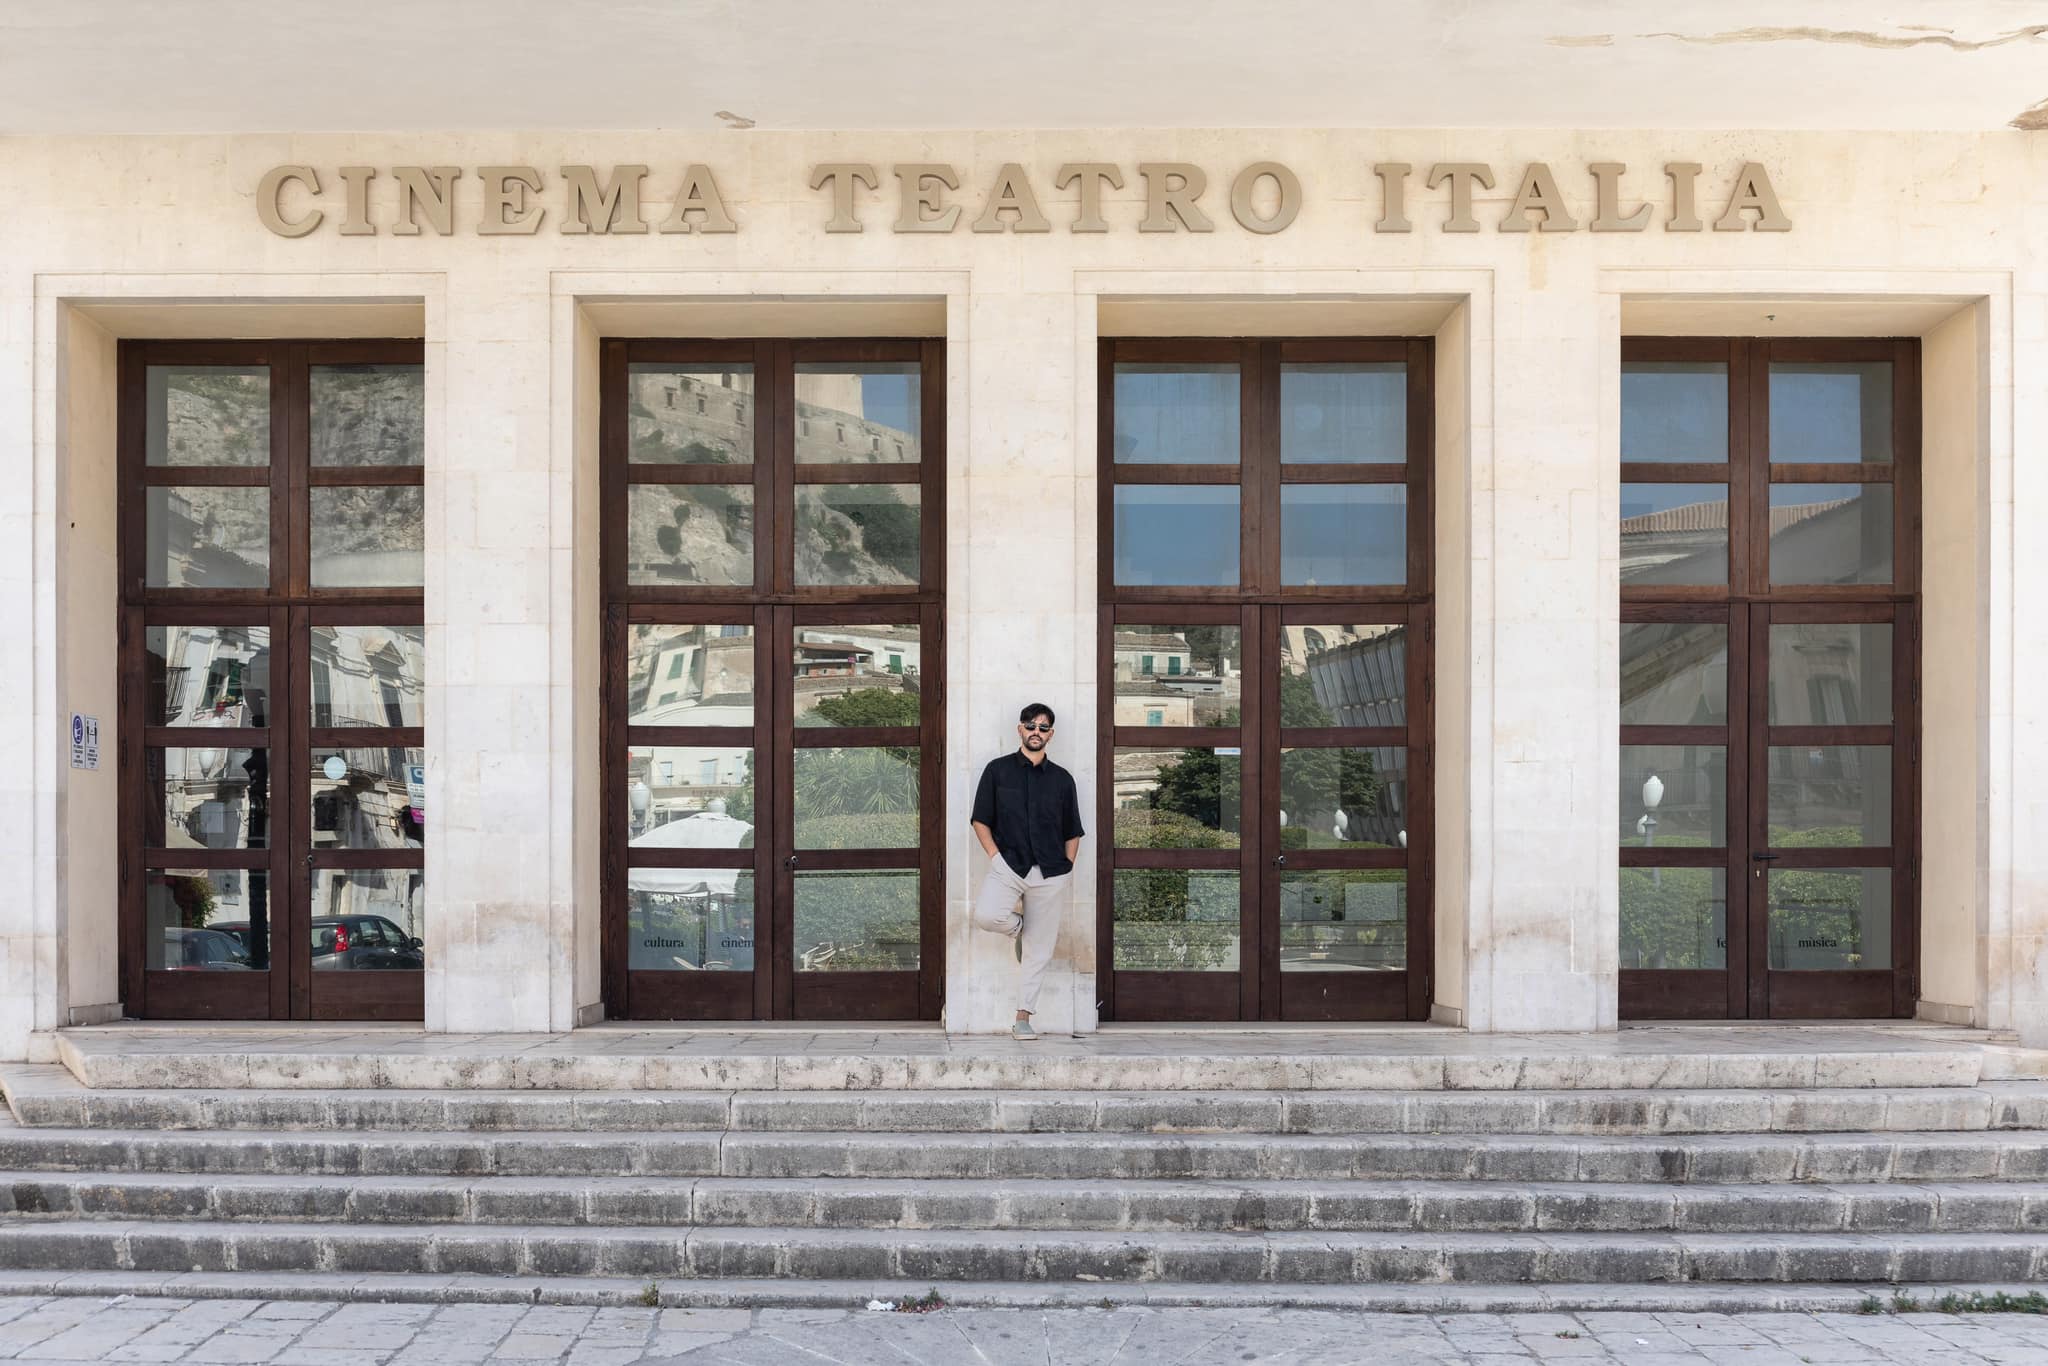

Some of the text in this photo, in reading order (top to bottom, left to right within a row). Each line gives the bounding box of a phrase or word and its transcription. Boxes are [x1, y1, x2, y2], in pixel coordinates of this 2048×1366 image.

[256, 162, 1793, 238] CINEMA TEATRO ITALIA
[643, 936, 685, 949] cultura
